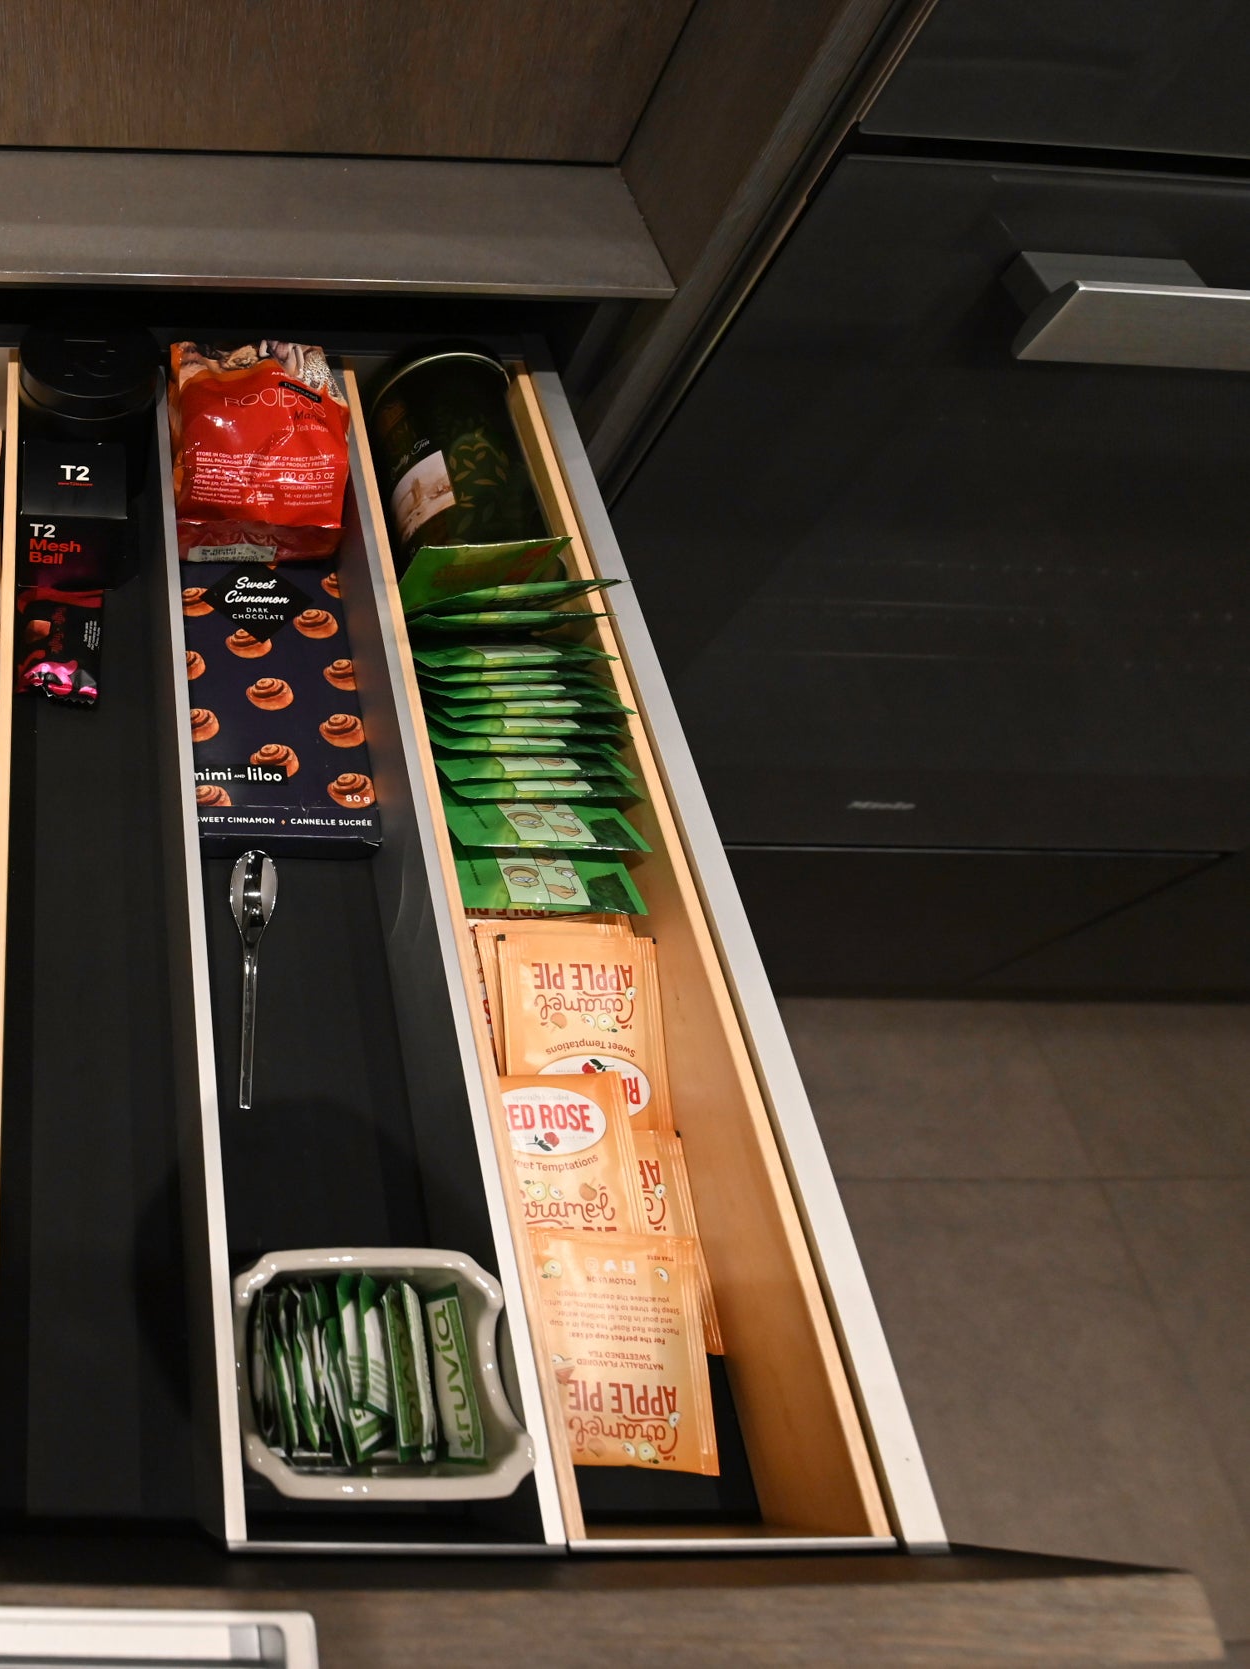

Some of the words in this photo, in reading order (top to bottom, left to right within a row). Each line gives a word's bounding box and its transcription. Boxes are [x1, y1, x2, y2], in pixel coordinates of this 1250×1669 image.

[224, 388, 326, 417] ROOIBOS
[60, 465, 90, 481] T2
[280, 472, 296, 480] 100
[298, 472, 321, 482] g/3.5
[30, 523, 56, 538] T2
[30, 538, 81, 553] Mesh
[29, 551, 63, 565] Ball
[235, 576, 277, 590] Sweet
[225, 589, 290, 605] Cinnamon
[247, 767, 282, 782] liloo
[346, 795, 361, 803] 80
[363, 796, 371, 804] g
[290, 818, 336, 826] CANNELLE
[338, 818, 372, 827] SUCRÉE
[531, 962, 564, 990] PIE
[570, 963, 633, 991] APPLE
[534, 992, 634, 1025] Caramel
[545, 1038, 606, 1056] Temptations
[608, 1041, 636, 1058] Sweet
[539, 1103, 594, 1133] ROSE
[536, 1154, 599, 1173] Temptations
[521, 1190, 616, 1223] aramel
[609, 1278, 636, 1286] FOLLOW
[630, 1295, 656, 1303] achieve
[661, 1306, 680, 1315] Steep
[549, 1319, 563, 1327] cup
[581, 1320, 594, 1329] bag
[642, 1316, 659, 1324] pour
[595, 1332, 609, 1340] cup
[632, 1326, 646, 1334] Red
[662, 1327, 679, 1335] Place
[611, 1333, 638, 1343] perfect
[640, 1336, 652, 1344] the
[654, 1337, 666, 1345] For
[588, 1350, 603, 1358] TEA
[605, 1351, 650, 1361] SWEETENED
[619, 1361, 664, 1371] NATURALLY
[568, 1379, 603, 1413] PIE
[609, 1382, 677, 1416] APPLE
[568, 1416, 678, 1455] Caramel
